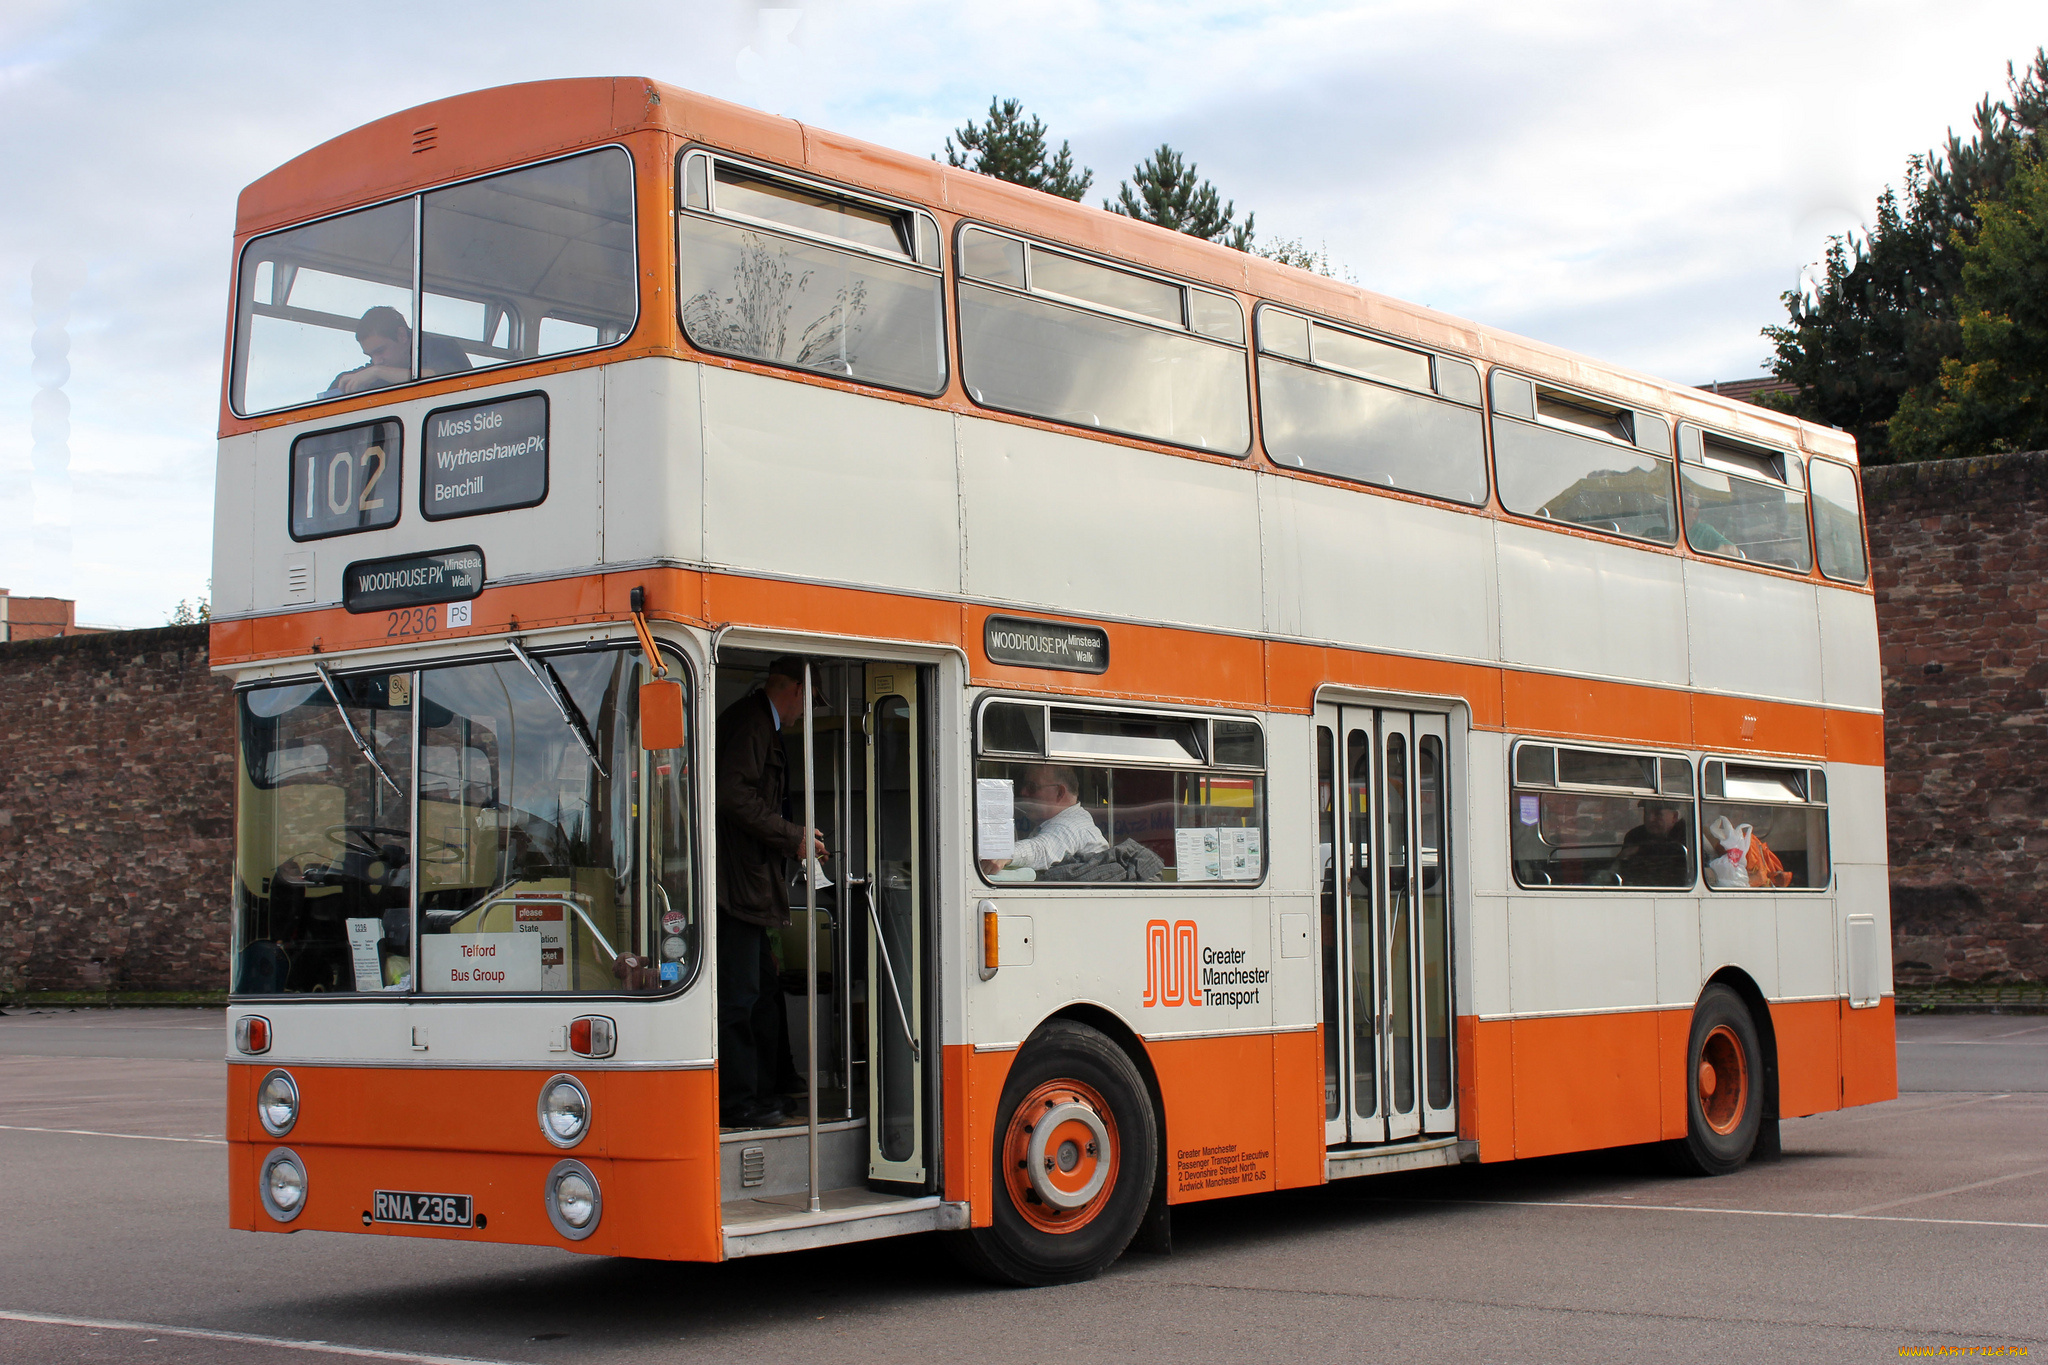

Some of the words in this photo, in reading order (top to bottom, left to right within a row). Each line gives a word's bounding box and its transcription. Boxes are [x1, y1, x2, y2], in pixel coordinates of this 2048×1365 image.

[438, 419, 472, 438] Moss
[473, 411, 503, 431] Side
[306, 445, 386, 519] 102
[435, 475, 484, 501] Benchill
[358, 567, 428, 593] WOODHOUSE
[451, 574, 472, 588] Walk
[386, 606, 437, 637] 2236
[451, 605, 468, 623] PS
[991, 631, 1055, 654] WOODHOUSE
[1067, 634, 1101, 648] Minstead
[1075, 651, 1094, 663] Walk
[519, 908, 543, 918] please
[519, 924, 539, 933] State
[461, 944, 496, 957] Telford
[1202, 946, 1246, 964] Greater
[451, 968, 470, 982] Bus
[473, 968, 505, 983] Group
[1202, 967, 1270, 986] Manchester
[1203, 987, 1260, 1010] Transport
[1177, 1149, 1201, 1160] Greater
[1202, 1144, 1237, 1156] Manchester
[1177, 1159, 1210, 1170] Passenger
[1211, 1153, 1240, 1165] Transport
[1241, 1150, 1270, 1161] Executive
[1178, 1171, 1183, 1181] 2
[1184, 1167, 1218, 1181] Devonshire
[1219, 1164, 1238, 1176] Street
[1239, 1161, 1257, 1173] North
[1178, 1180, 1204, 1192] Ardwick
[1205, 1175, 1240, 1188] Manchester
[1241, 1172, 1253, 1183] M12
[1254, 1170, 1267, 1181] 6JS
[376, 1194, 414, 1220] RNA
[417, 1196, 470, 1224] 236J
